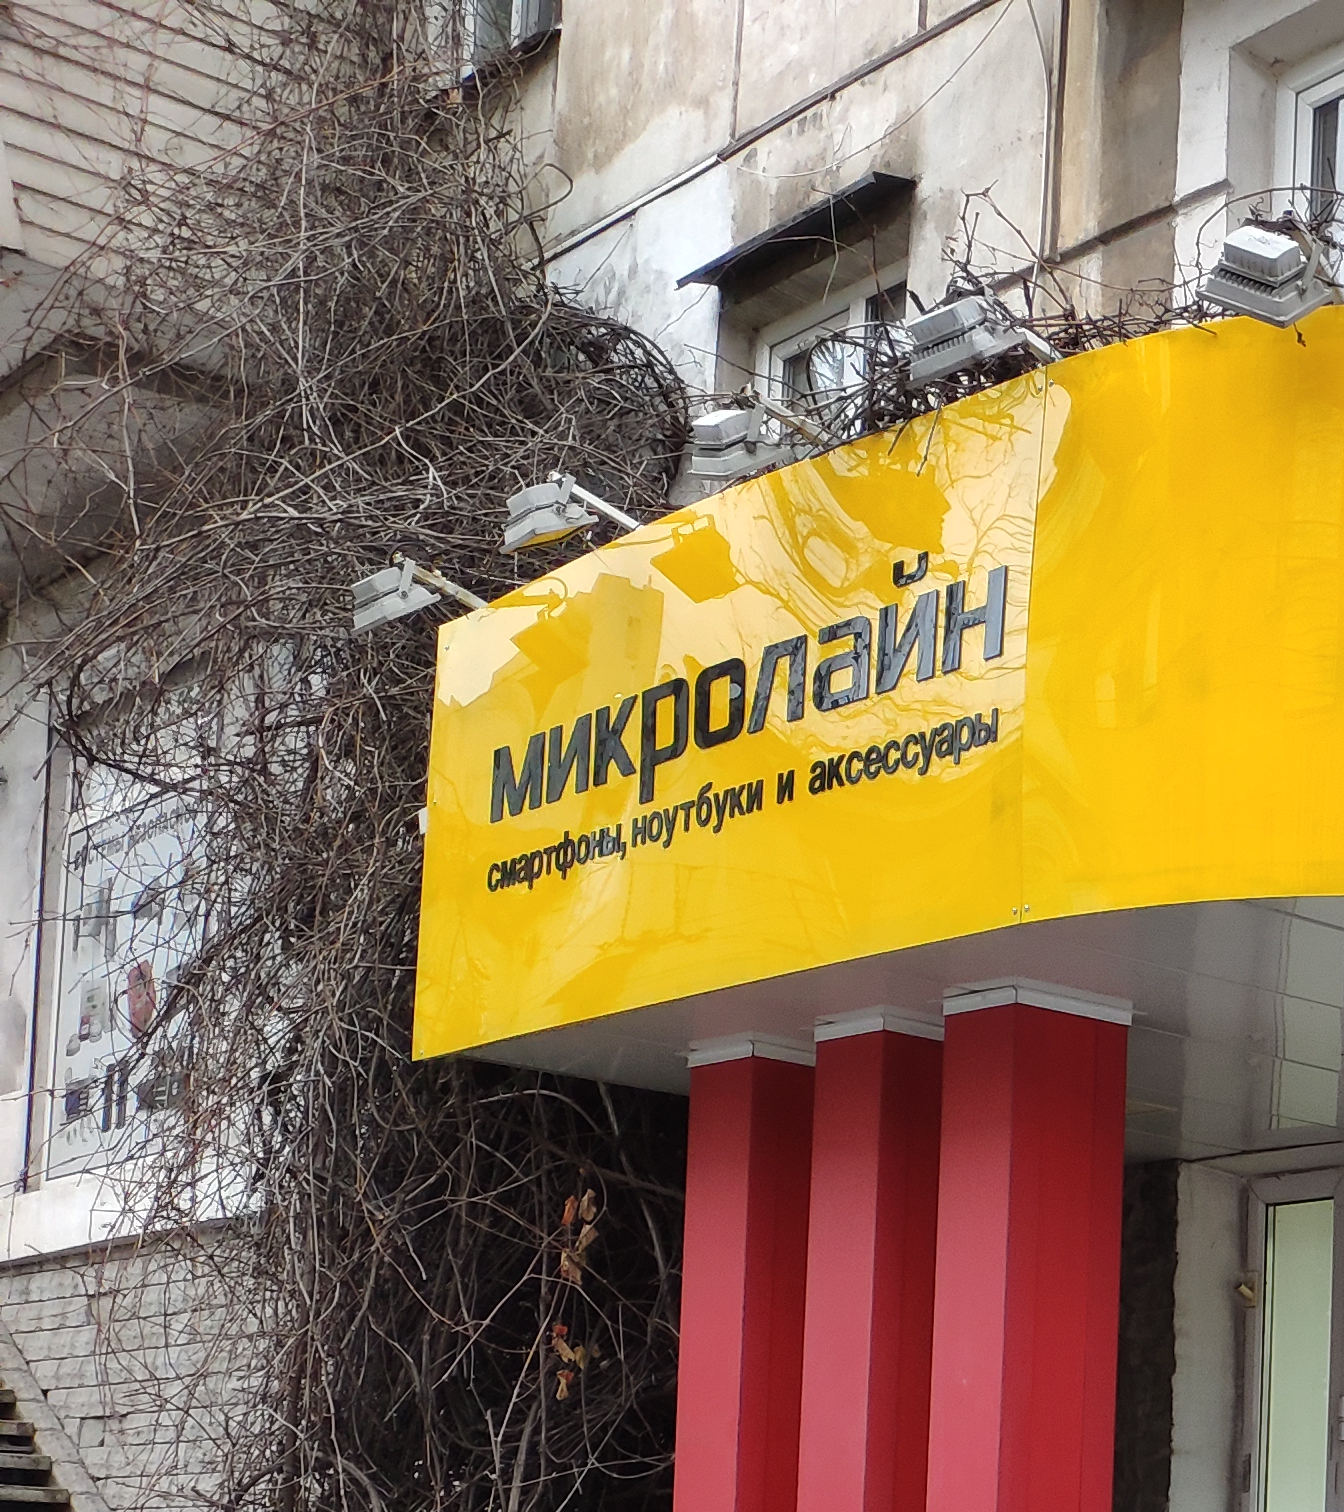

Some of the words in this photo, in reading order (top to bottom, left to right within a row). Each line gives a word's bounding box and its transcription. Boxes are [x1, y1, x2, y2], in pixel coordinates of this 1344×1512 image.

[487, 821, 626, 893] смартфоны,
[631, 779, 763, 848] ноутбуки
[776, 766, 795, 803] и
[809, 708, 998, 794] аксессуары
[489, 552, 1008, 824] микролайн
